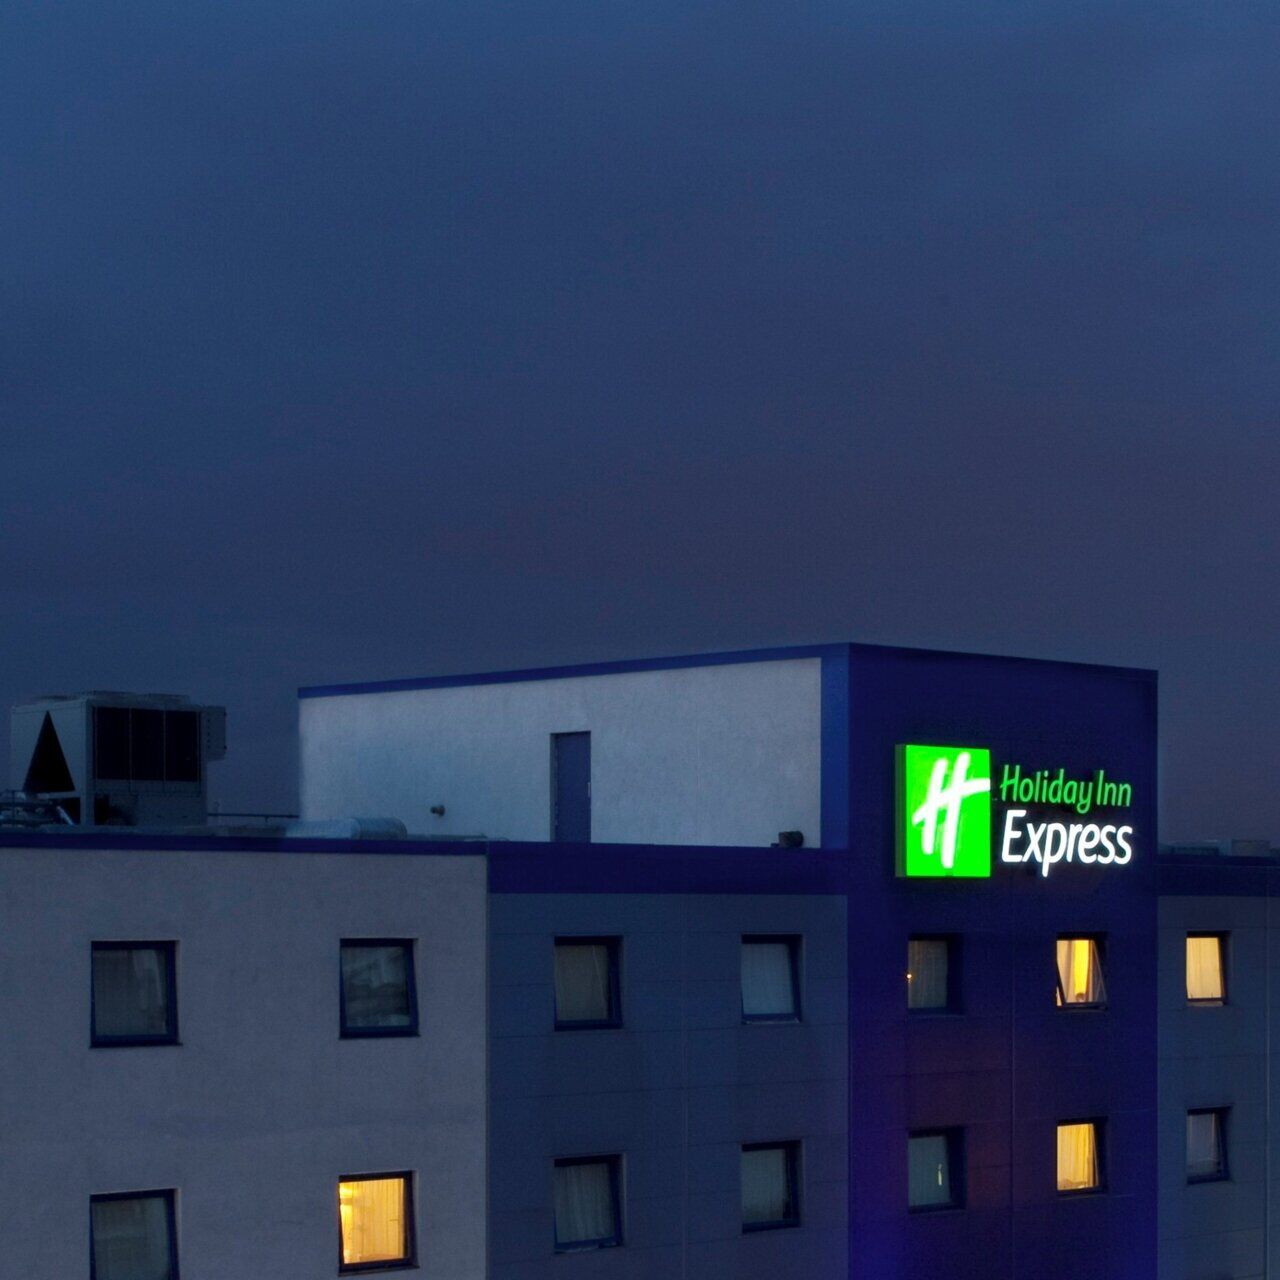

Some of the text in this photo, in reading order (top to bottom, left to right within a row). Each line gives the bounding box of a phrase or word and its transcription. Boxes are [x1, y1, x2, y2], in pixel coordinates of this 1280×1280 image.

[1000, 764, 1132, 814] Holiday Inn
[1001, 809, 1133, 878] Express
